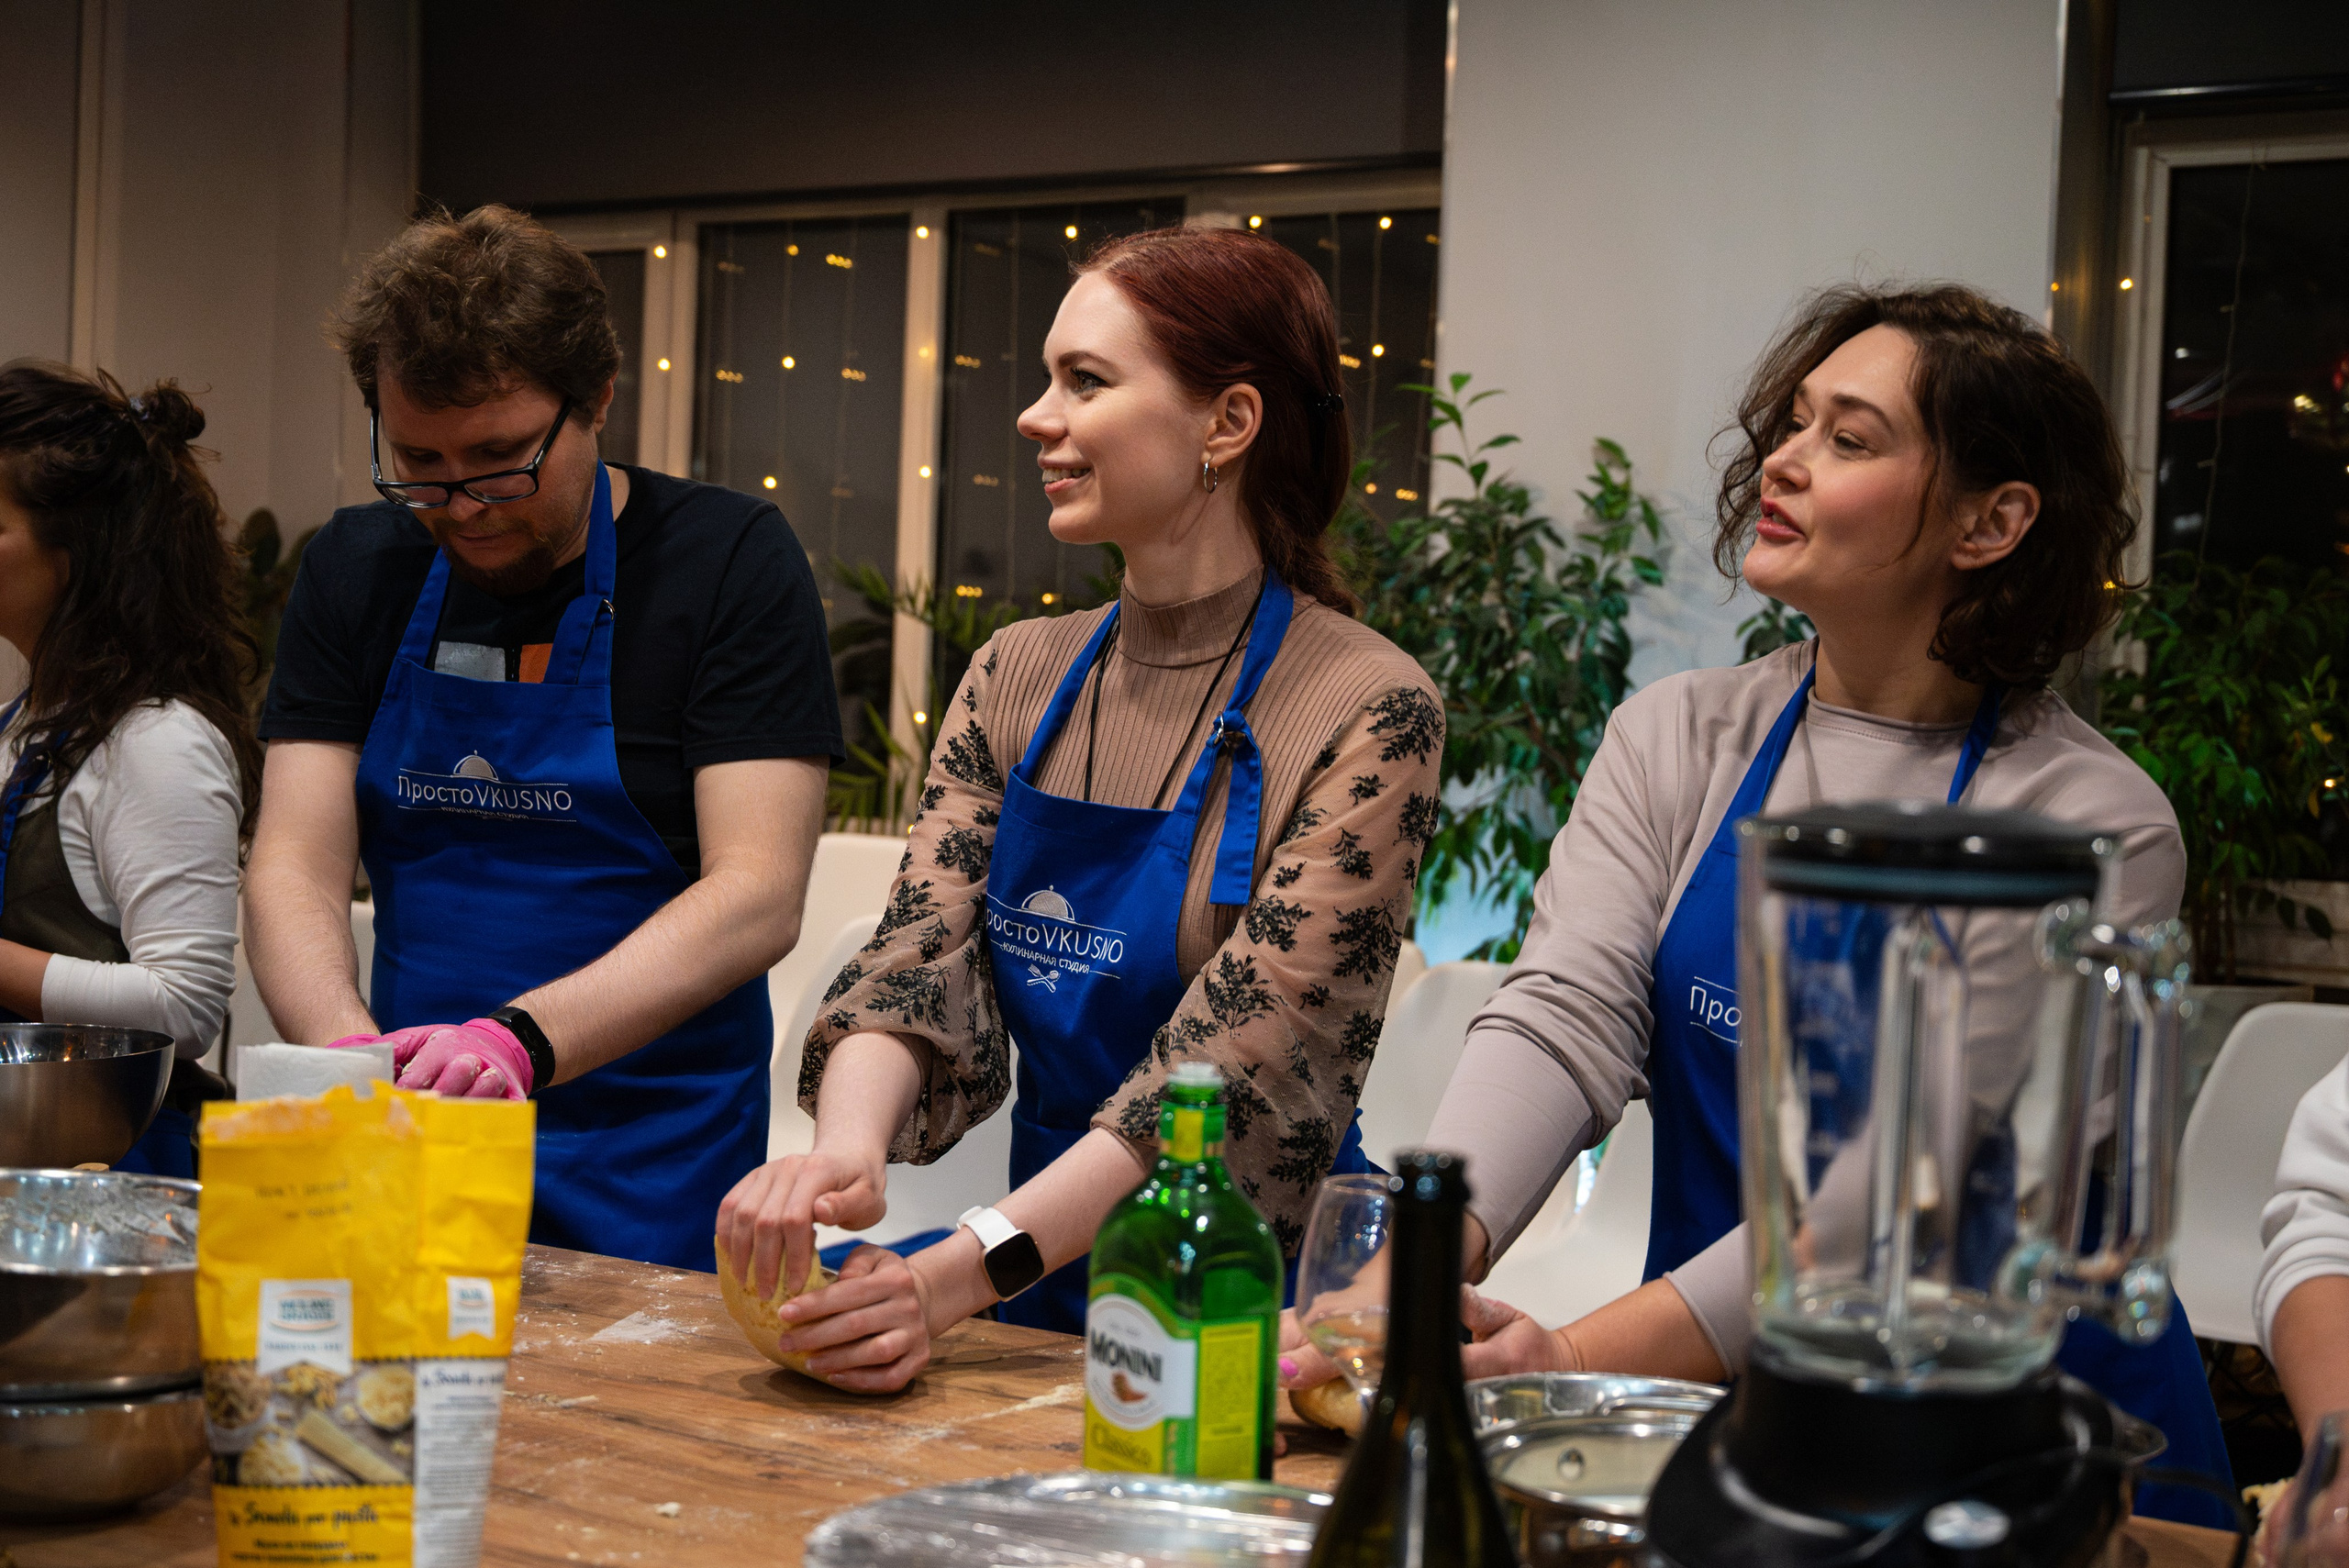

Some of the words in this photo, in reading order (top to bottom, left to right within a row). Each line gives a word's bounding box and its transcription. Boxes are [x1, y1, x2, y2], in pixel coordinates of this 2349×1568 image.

[986, 907, 1124, 963] ростоVKUSNO
[1002, 941, 1056, 967] КУЛИНАРНАЯ
[1058, 958, 1090, 974] СТУДИЯ
[1689, 985, 1742, 1027] Про
[1090, 1329, 1163, 1385] MONINI
